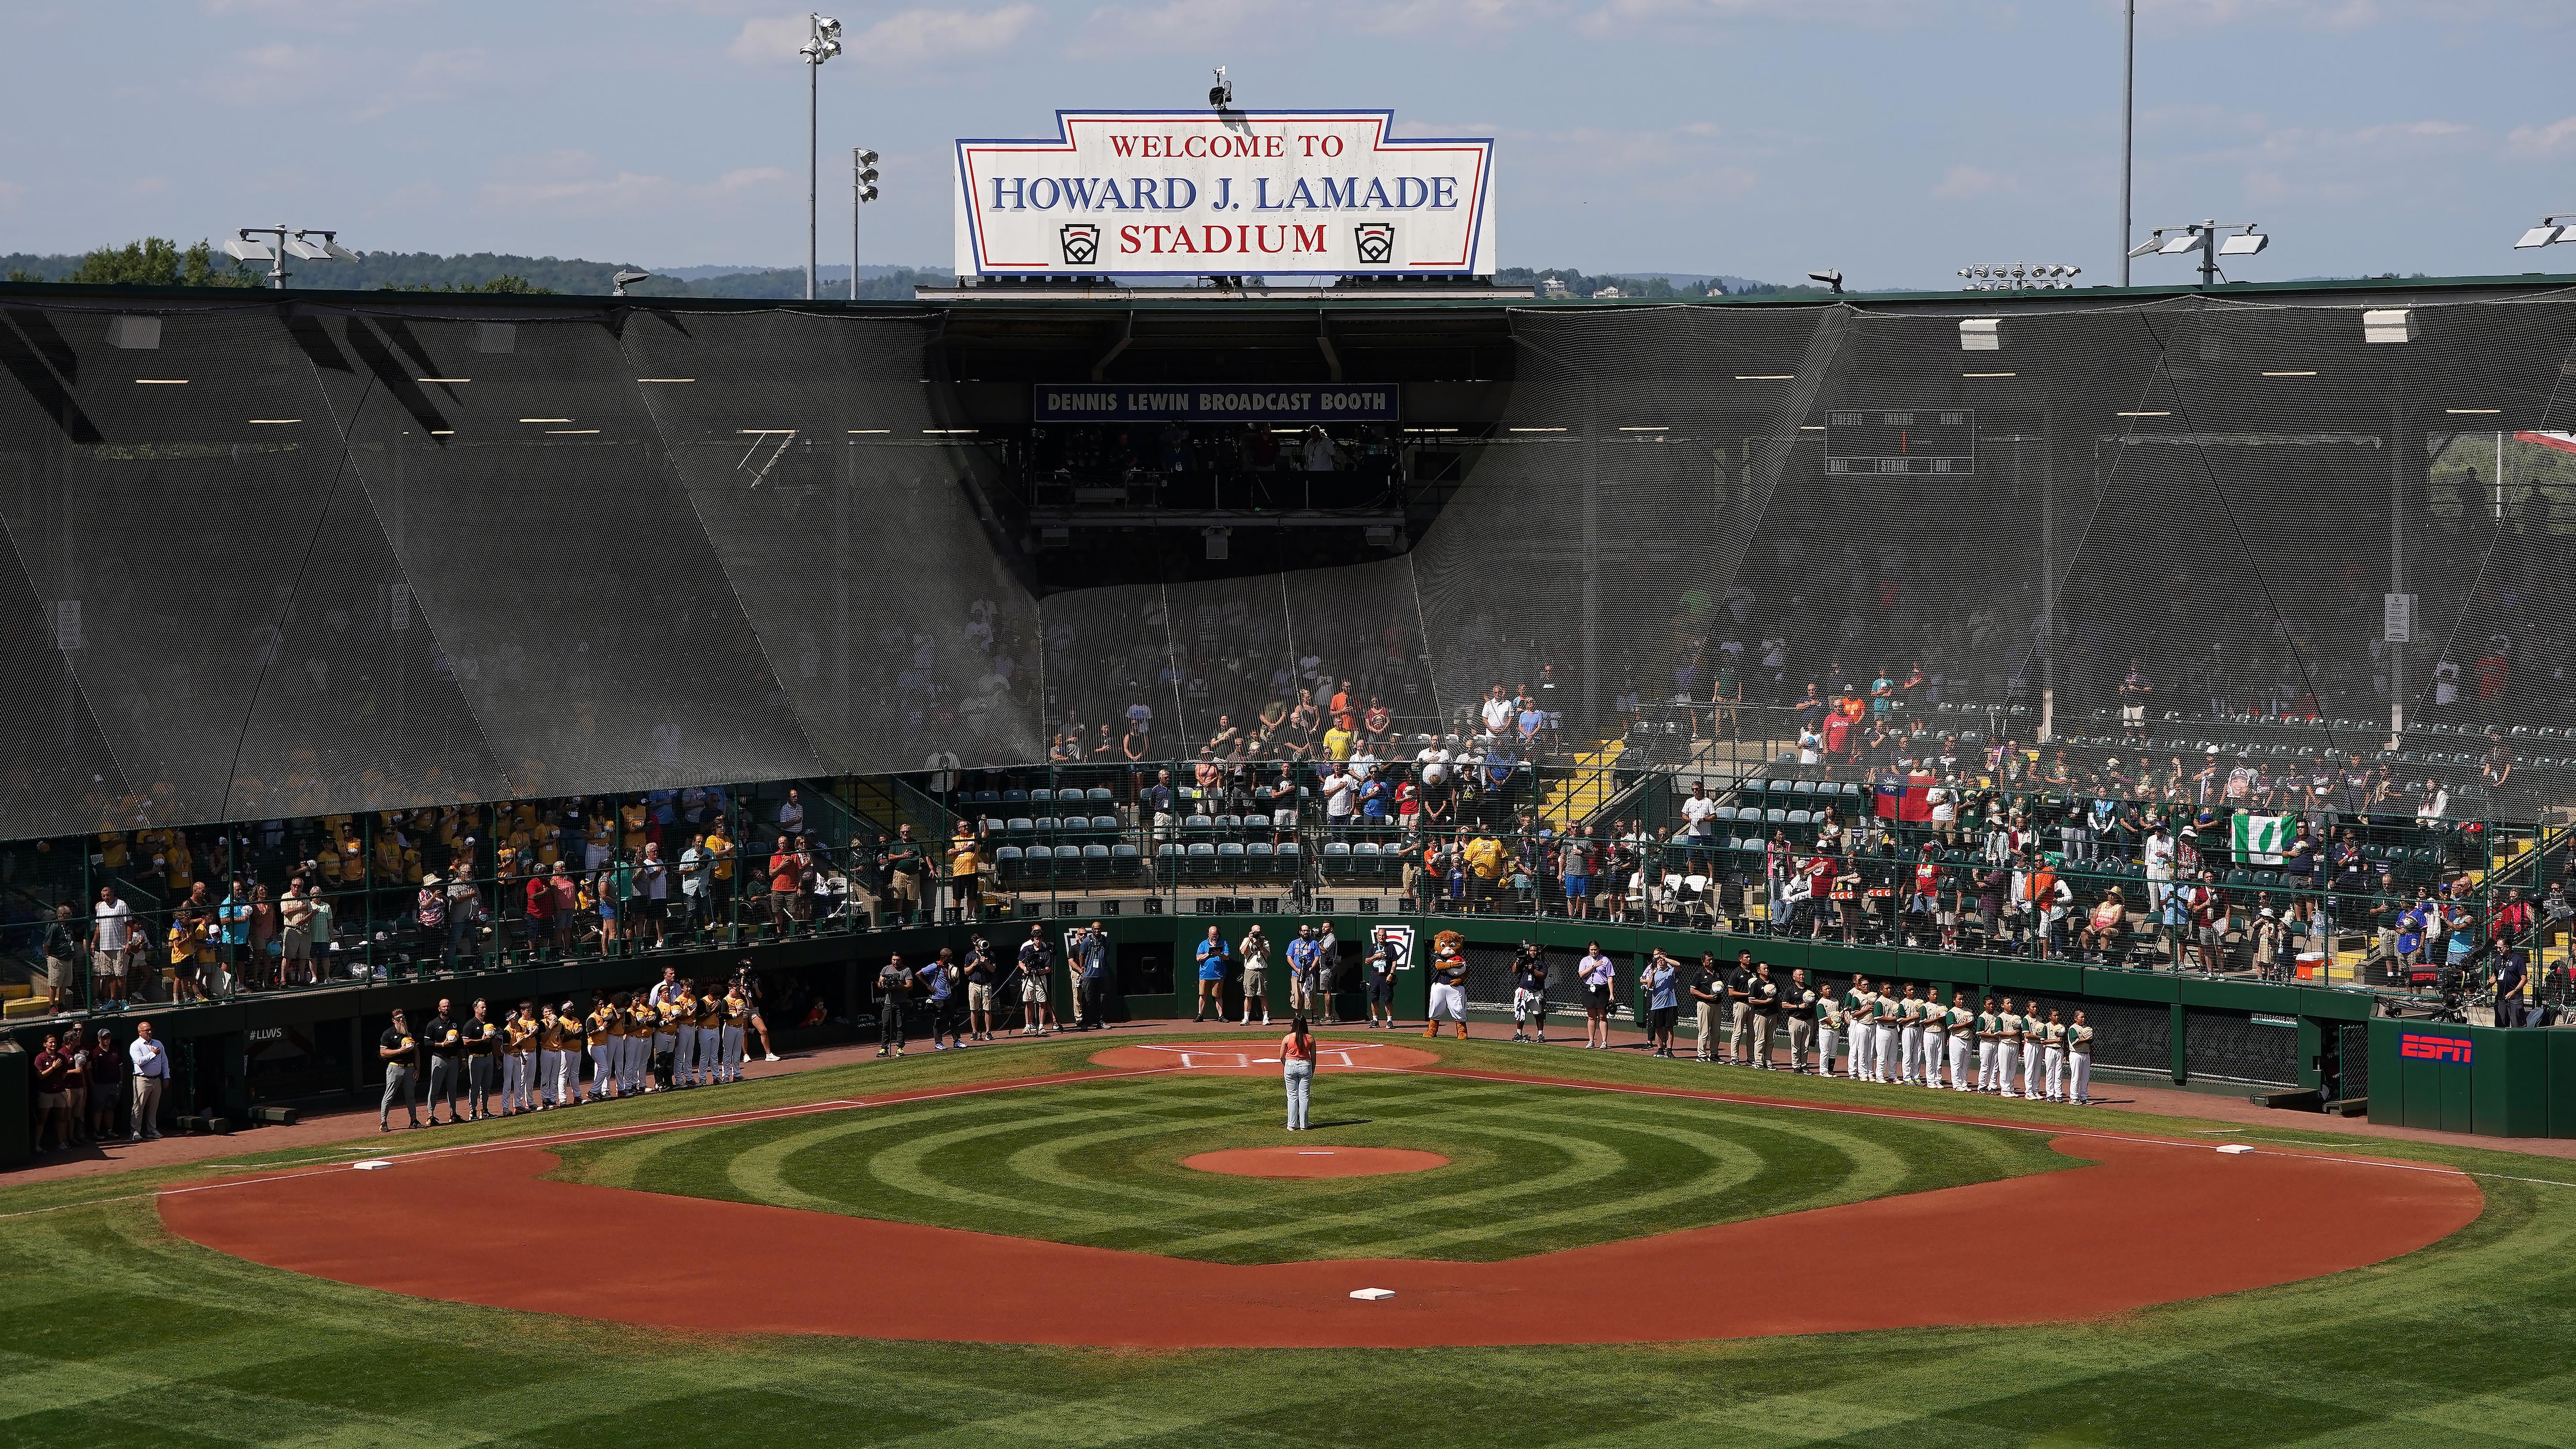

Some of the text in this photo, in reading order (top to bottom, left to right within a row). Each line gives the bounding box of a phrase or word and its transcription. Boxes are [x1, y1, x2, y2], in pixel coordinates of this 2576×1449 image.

[1111, 136, 1344, 158] WELCOME TO
[989, 177, 1459, 212] HOWARD J. LAMADE
[1121, 225, 1327, 254] STADIUM
[1048, 393, 1386, 411] DENNIS LEWIN BROADCAST BOOTH
[1832, 413, 1963, 425] GUESTS INNING HOME
[1830, 459, 1951, 472] BALL STRIKE OUT
[2412, 973, 2436, 981] ESPN
[2251, 1013, 2297, 1025] LITTLELEAGUE.ORG
[249, 1028, 282, 1041] #LLWS
[2401, 1034, 2472, 1063] ESPN
